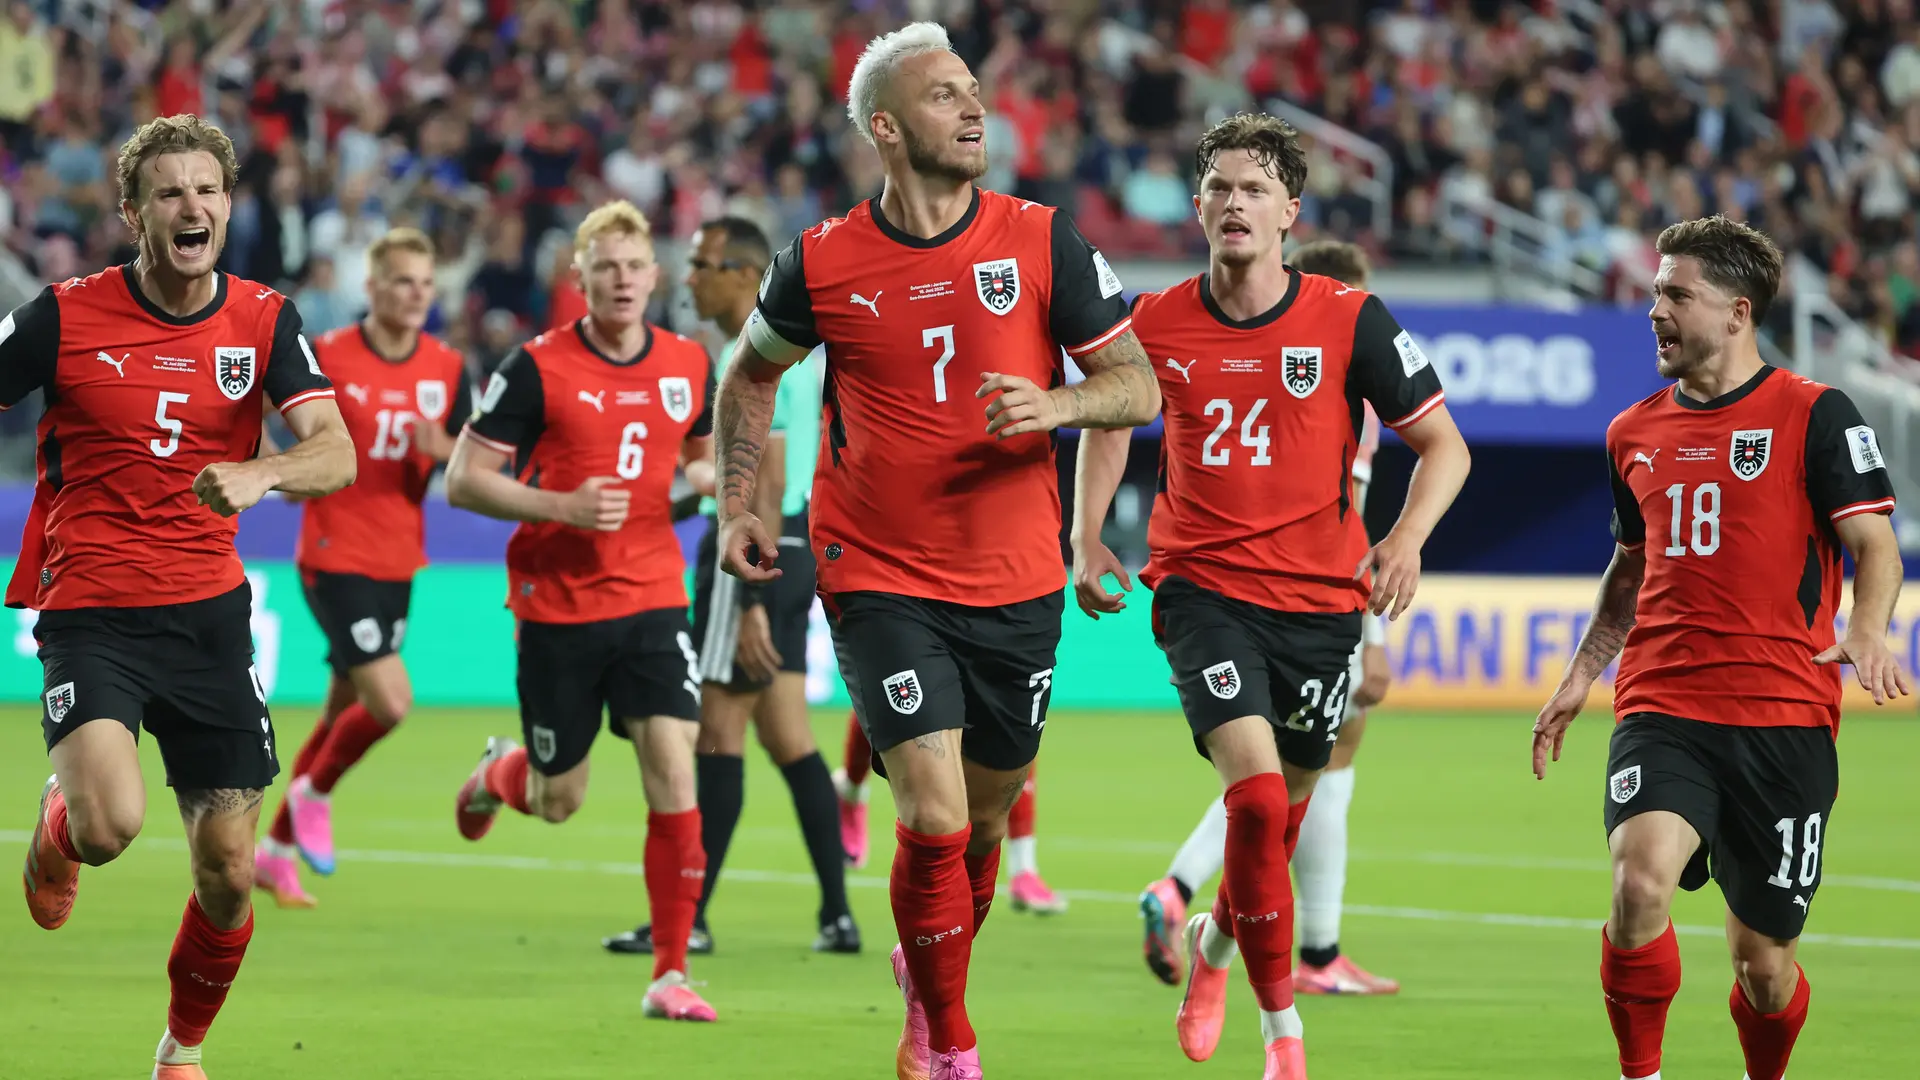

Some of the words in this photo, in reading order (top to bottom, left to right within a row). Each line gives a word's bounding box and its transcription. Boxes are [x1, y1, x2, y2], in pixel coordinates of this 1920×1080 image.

[922, 324, 955, 403] 7
[1408, 333, 1596, 406] 026
[150, 391, 191, 457] 5
[368, 409, 418, 461] 15
[616, 421, 649, 480] 6
[1202, 398, 1272, 466] 24
[1665, 482, 1721, 556] 18
[1384, 609, 1504, 684] AN
[1029, 668, 1053, 727] 7
[1285, 671, 1347, 733] 24
[1767, 812, 1822, 889] 18
[916, 925, 963, 946] ÖFB
